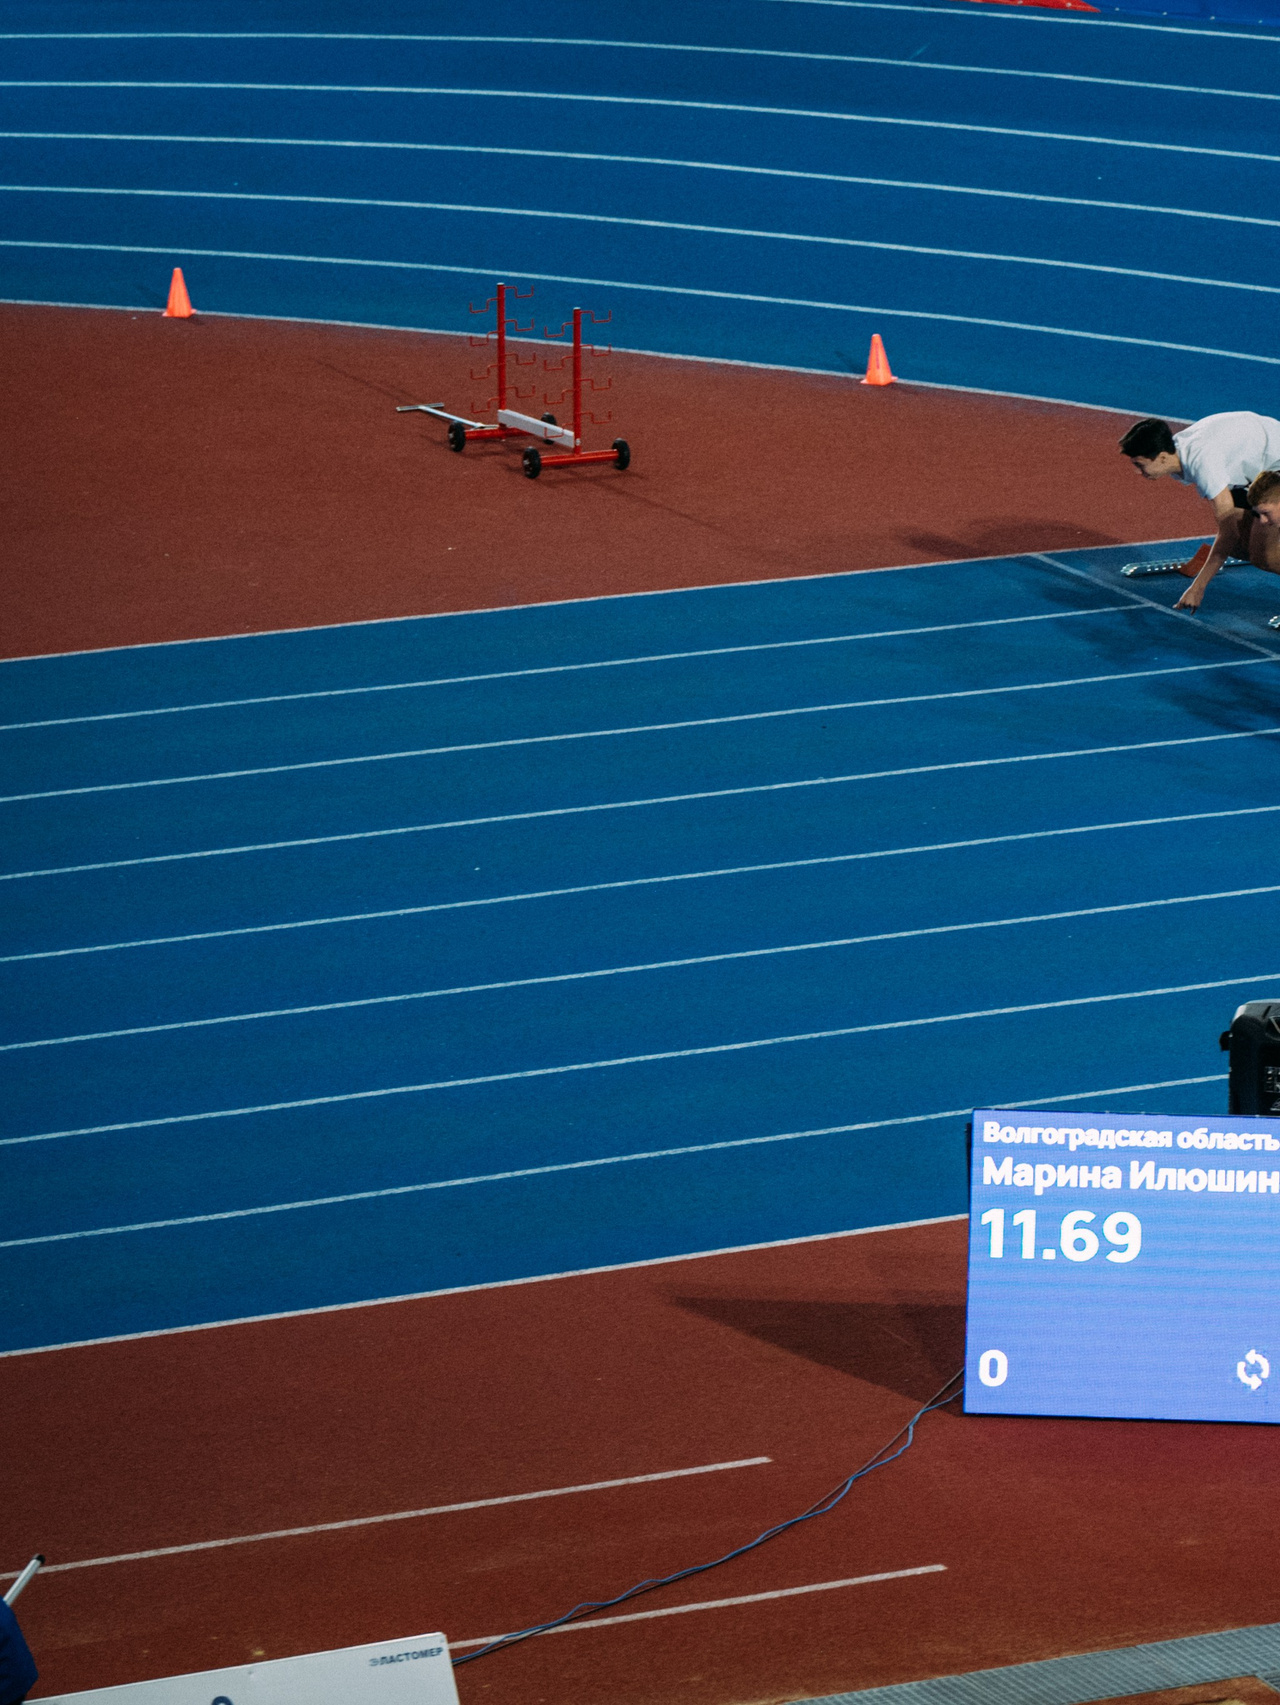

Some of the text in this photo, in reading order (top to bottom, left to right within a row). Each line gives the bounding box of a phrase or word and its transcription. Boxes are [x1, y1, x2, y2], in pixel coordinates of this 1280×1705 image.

[983, 1121, 1280, 1152] Волгоградская область
[983, 1156, 1123, 1195] Марина
[981, 1208, 1142, 1263] 11.69
[979, 1349, 1008, 1387] 0
